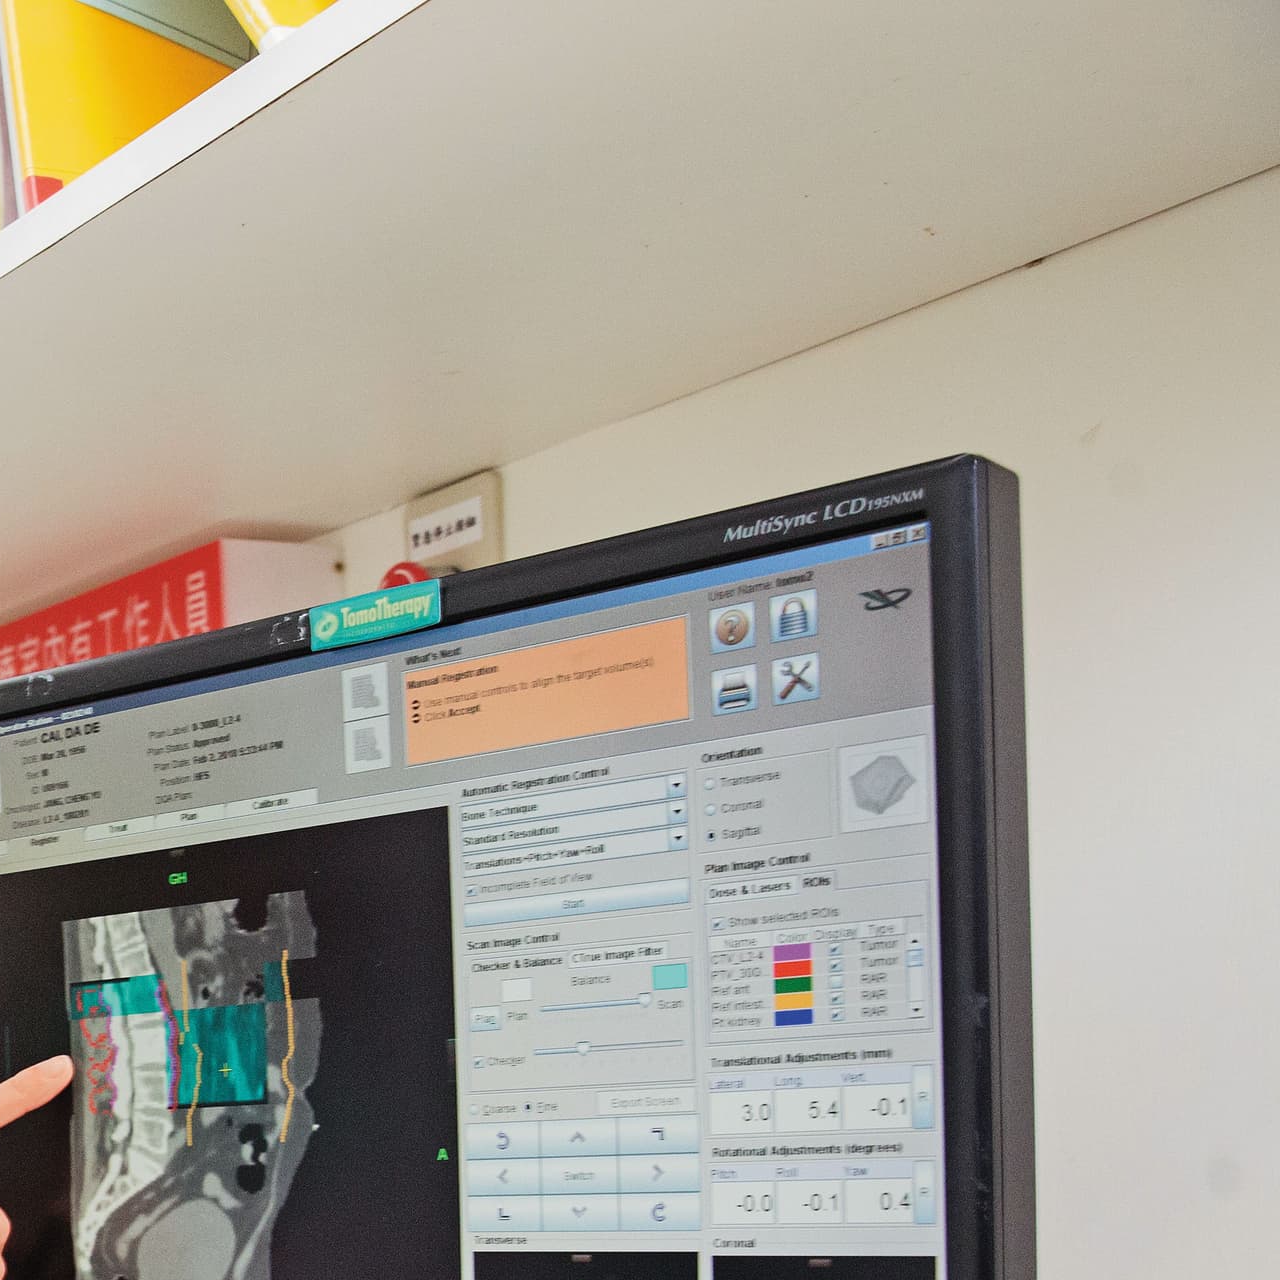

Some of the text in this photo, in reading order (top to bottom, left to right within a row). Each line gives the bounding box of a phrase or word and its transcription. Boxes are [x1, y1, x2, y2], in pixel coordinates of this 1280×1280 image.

[723, 510, 819, 543] MultiSync
[341, 593, 434, 628] TomoTherapy
[405, 652, 437, 665] What's
[407, 665, 498, 689] Manual Registration
[445, 692, 478, 704] manual
[481, 684, 518, 697] controls
[531, 676, 554, 690] align
[557, 673, 572, 684] the
[574, 668, 601, 682] target
[425, 704, 480, 722] Click Accept
[65, 727, 81, 740] DA
[84, 722, 101, 735] DE
[701, 745, 763, 764] Orientation
[461, 765, 611, 798] Automatic Registration Control
[720, 770, 782, 787] Transverse
[489, 803, 538, 818] Technique
[721, 799, 764, 814] Coronal
[463, 825, 560, 847] Standard Resolution
[722, 826, 762, 842] Sagittal
[704, 852, 811, 874] Plan Image Control
[168, 872, 188, 885] GH
[762, 909, 808, 924] selected
[467, 932, 560, 951] Scan Image Control
[711, 1054, 781, 1068] Translational
[785, 1050, 857, 1065] Adjustments
[741, 1097, 908, 1123] 3.0 5.4 -0.1
[437, 1148, 449, 1160] A
[711, 1146, 767, 1157] Rotational
[770, 1144, 842, 1158] Adjustments
[736, 1191, 912, 1213] -0.0 -0.1 0.4
